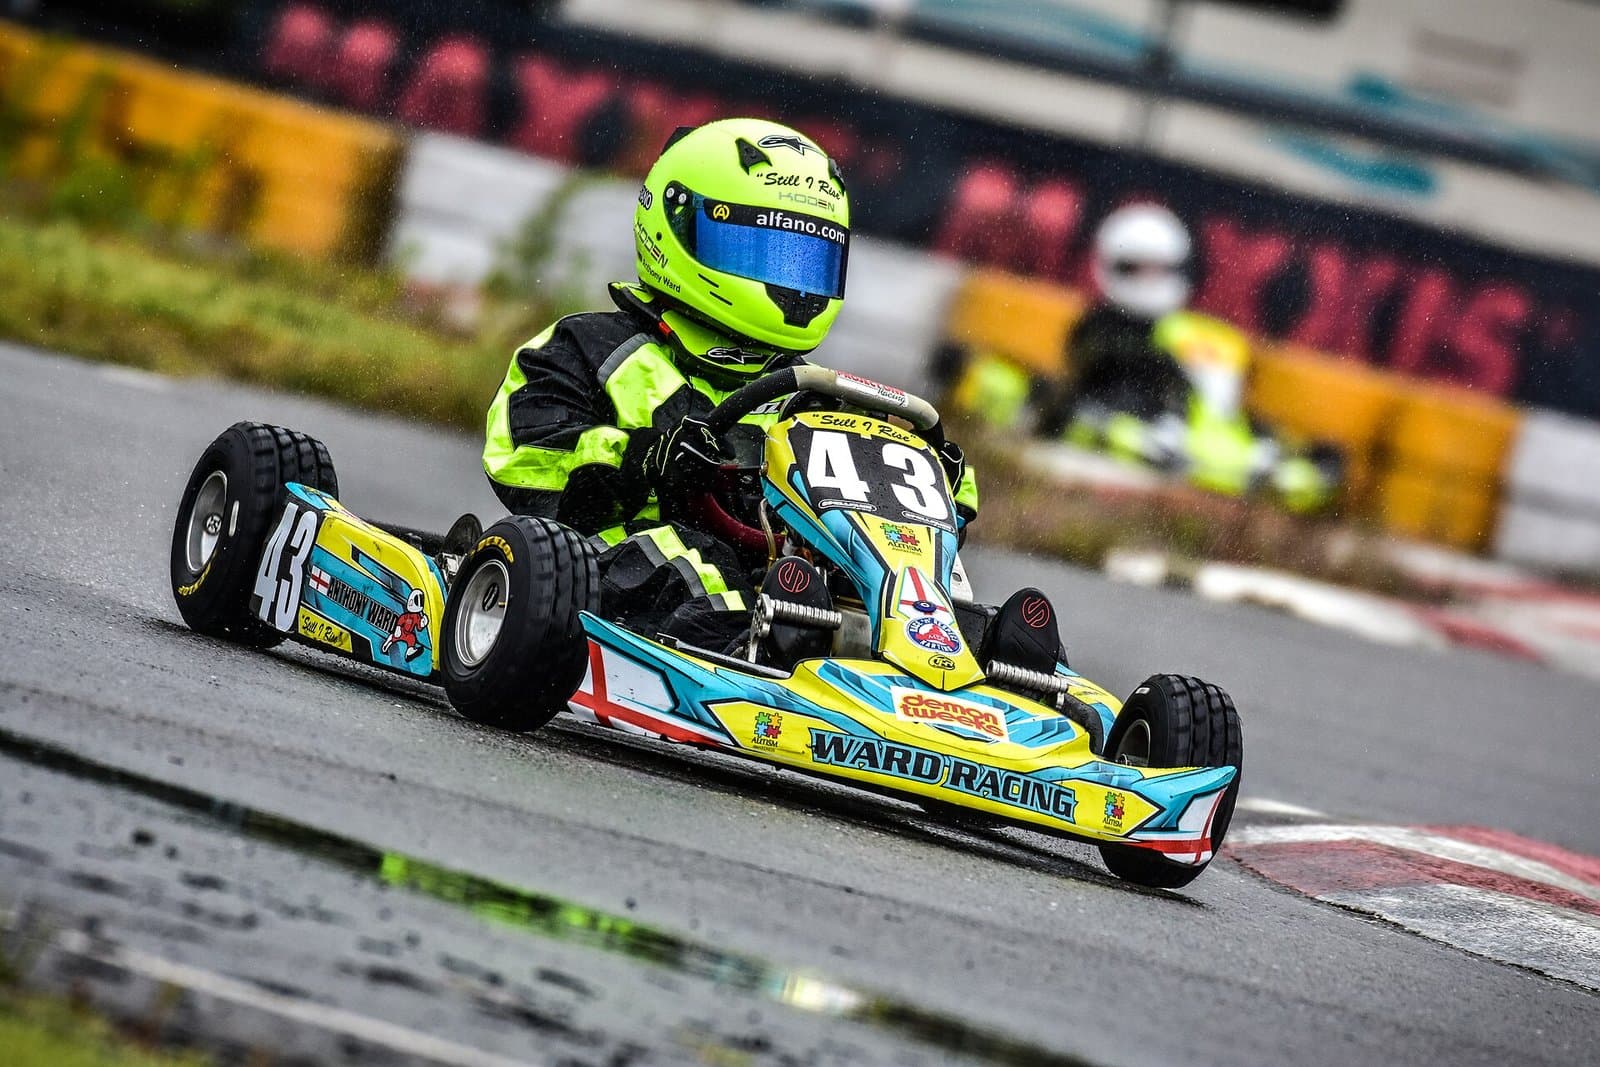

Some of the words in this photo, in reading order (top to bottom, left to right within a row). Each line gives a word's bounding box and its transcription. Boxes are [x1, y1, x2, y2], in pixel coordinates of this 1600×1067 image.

[756, 211, 846, 245] alfano.com
[662, 275, 681, 293] Ward
[807, 430, 949, 519] 43
[253, 501, 318, 633] 43
[327, 576, 370, 619] ANTHONY
[367, 600, 400, 635] WARD
[902, 695, 999, 725] demon
[751, 736, 778, 747] AUTISM
[813, 732, 941, 781] WARD
[949, 758, 1075, 819] RACING
